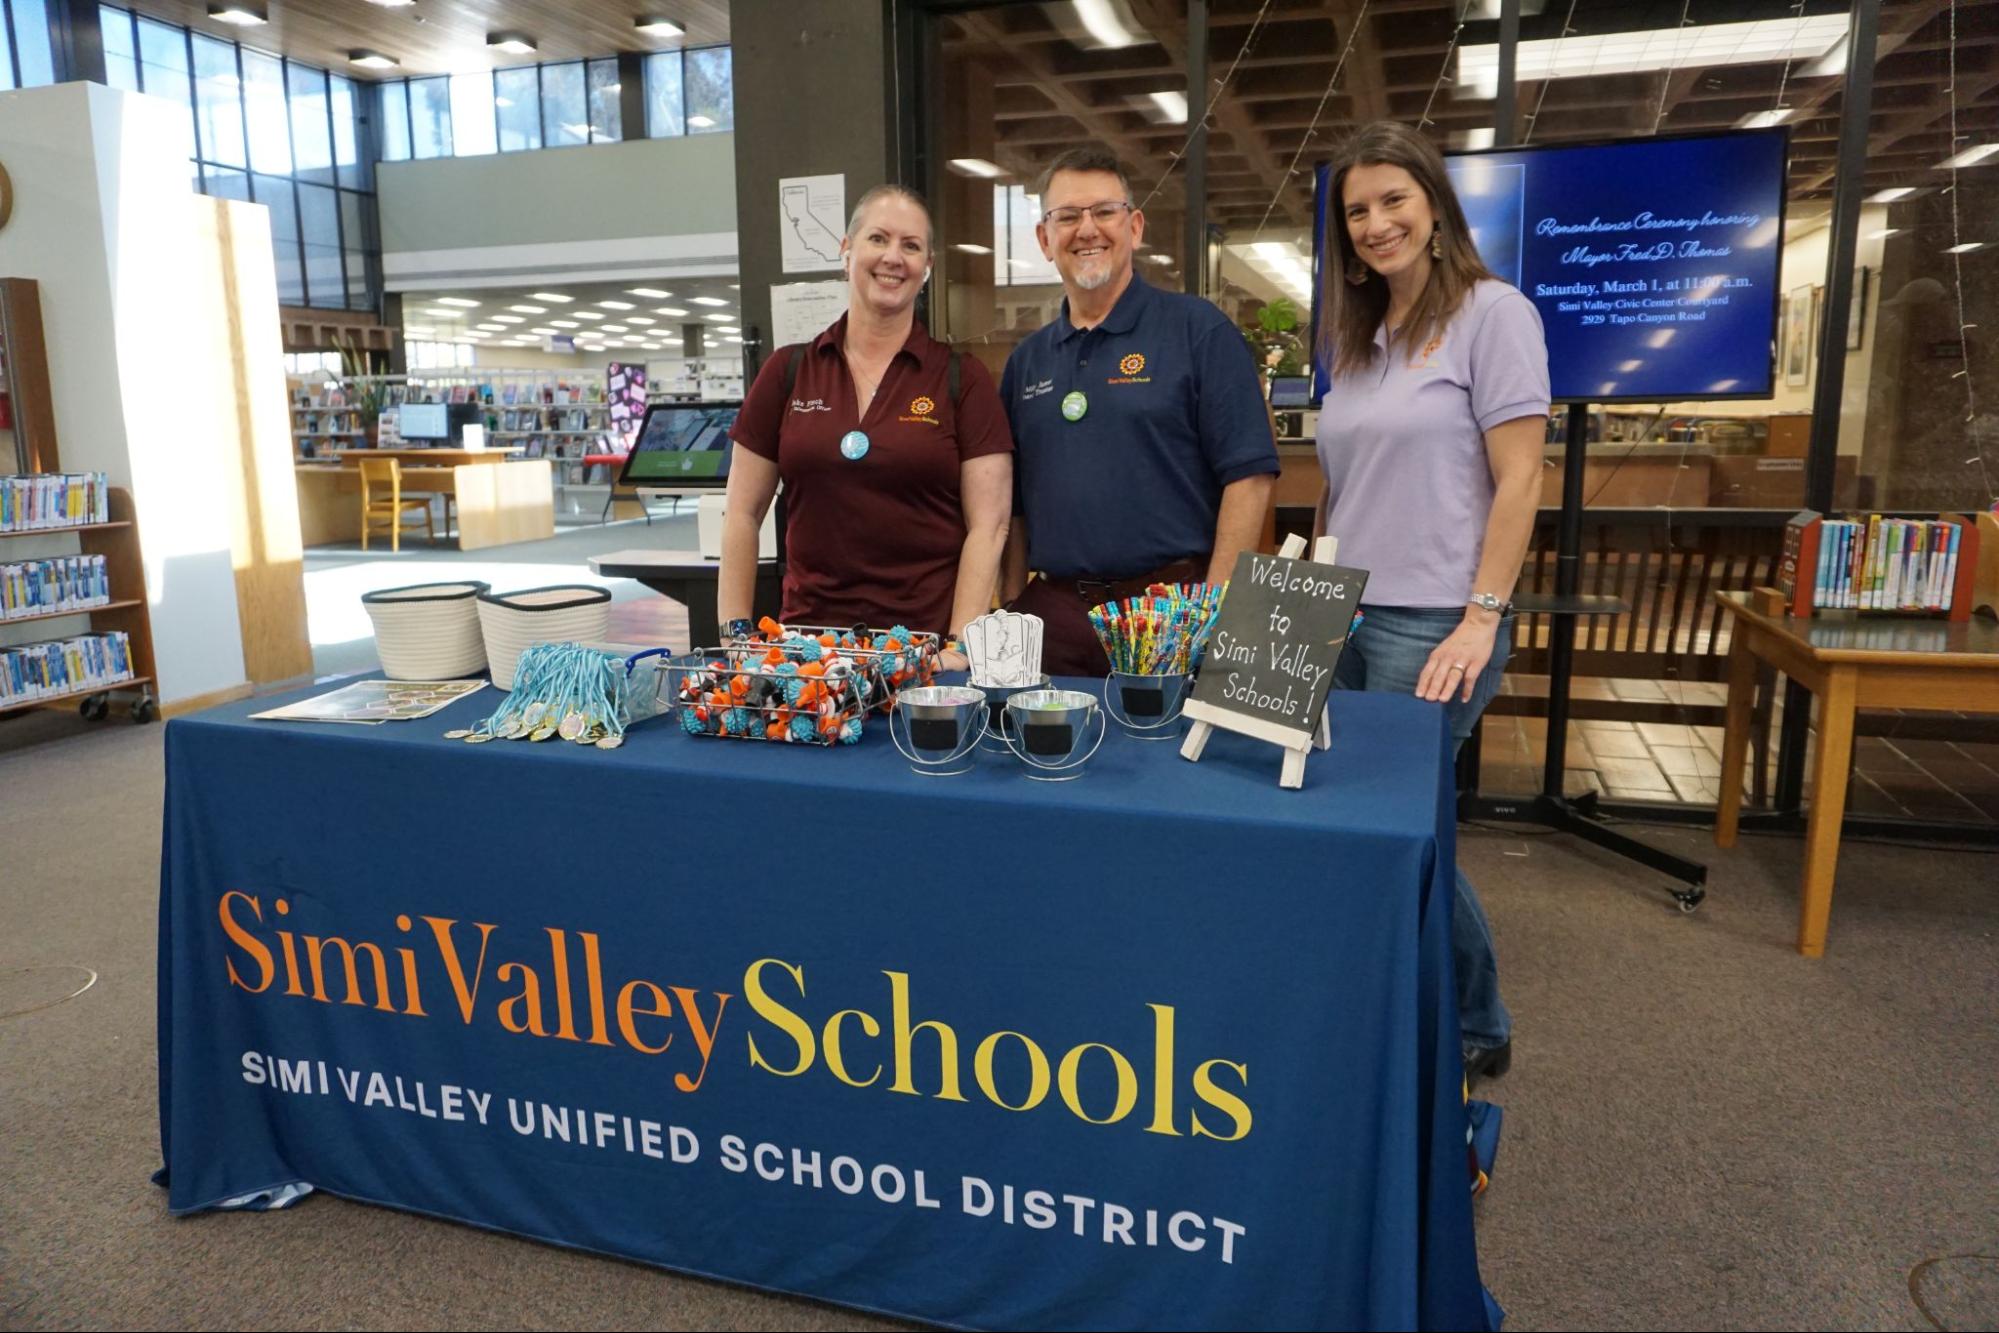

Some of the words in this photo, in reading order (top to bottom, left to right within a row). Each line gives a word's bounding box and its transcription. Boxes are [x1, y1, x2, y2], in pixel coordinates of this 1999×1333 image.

[1536, 217, 1633, 236] Remembrance
[1634, 211, 1699, 231] Ceremony
[1701, 211, 1760, 228] honoring
[1561, 246, 1612, 267] Mayor
[1613, 243, 1655, 260] Fred
[1651, 241, 1676, 260] D.
[1679, 240, 1732, 258] Thomas
[1536, 282, 1600, 296] Saturday,
[1603, 279, 1648, 293] March
[1651, 279, 1663, 292] 1,
[1666, 279, 1680, 290] at
[1723, 276, 1753, 288] a.m.
[1558, 302, 1581, 312] Simi
[1583, 299, 1613, 311] Valley
[1615, 298, 1640, 309] Civic
[1642, 298, 1674, 308] Center
[1676, 295, 1729, 307] Courtyard
[1581, 315, 1606, 325] 2929
[1609, 312, 1636, 325] Tapo
[1638, 311, 1676, 324] Canyon
[1678, 311, 1706, 321] Road
[1251, 557, 1345, 600] Welcome
[1269, 605, 1291, 636] to
[1213, 631, 1258, 664] Simi
[1270, 642, 1328, 690] Valley
[241, 1051, 328, 1095] SIMI
[336, 1067, 492, 1125] VALLEY
[508, 1098, 700, 1164] UNIFIED
[719, 1134, 941, 1209] SCHOOL
[962, 1176, 1246, 1264] DISTRICT
